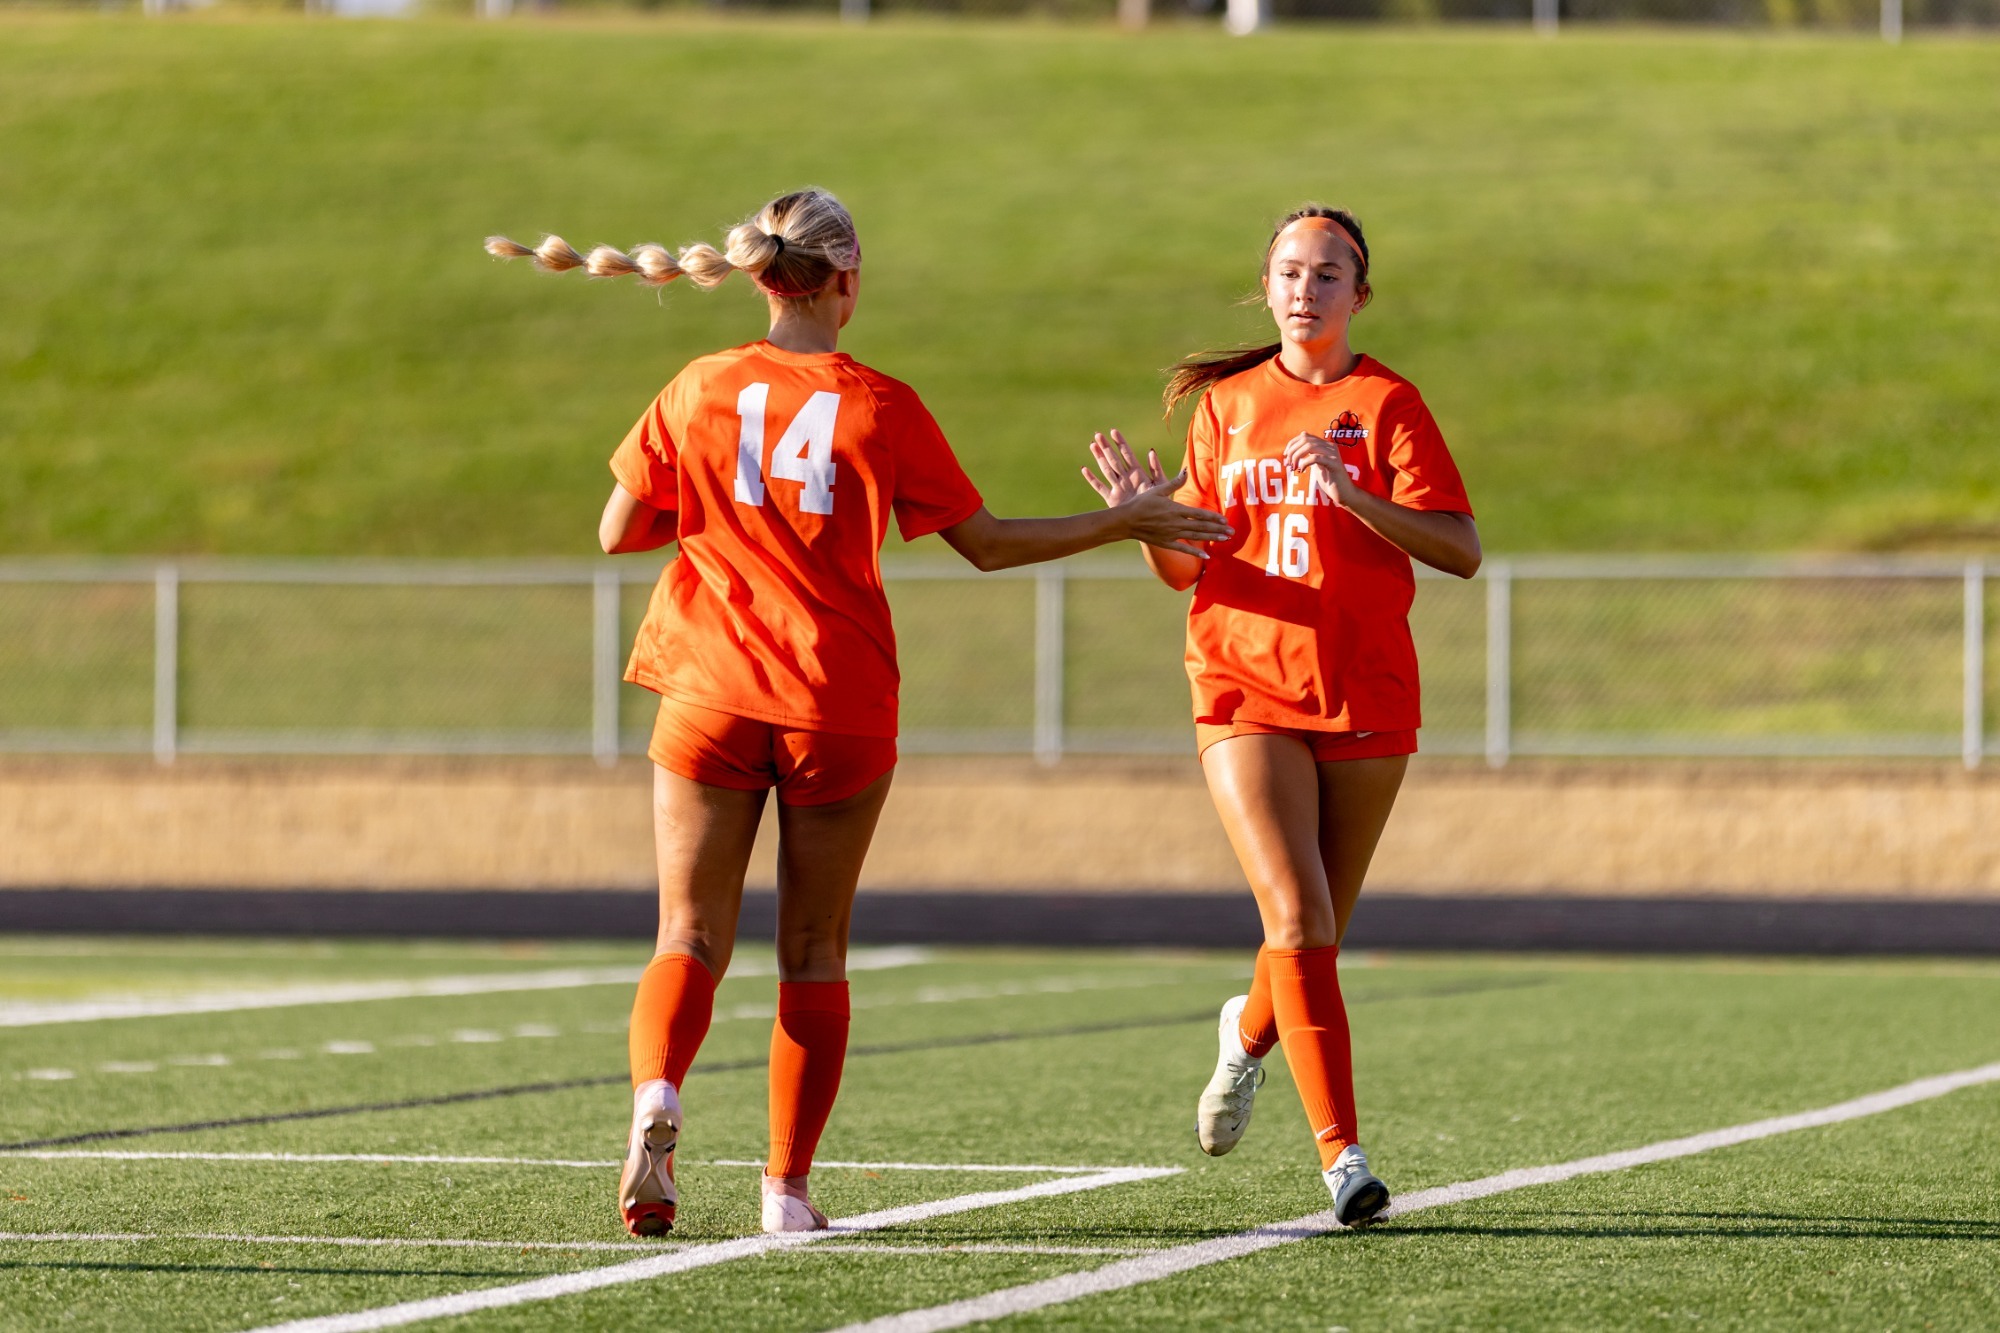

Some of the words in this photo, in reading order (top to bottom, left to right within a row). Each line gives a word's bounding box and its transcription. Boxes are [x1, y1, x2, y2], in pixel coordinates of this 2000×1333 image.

[733, 381, 841, 515] 14
[1323, 429, 1369, 439] TIGERS
[1265, 512, 1309, 578] 16
